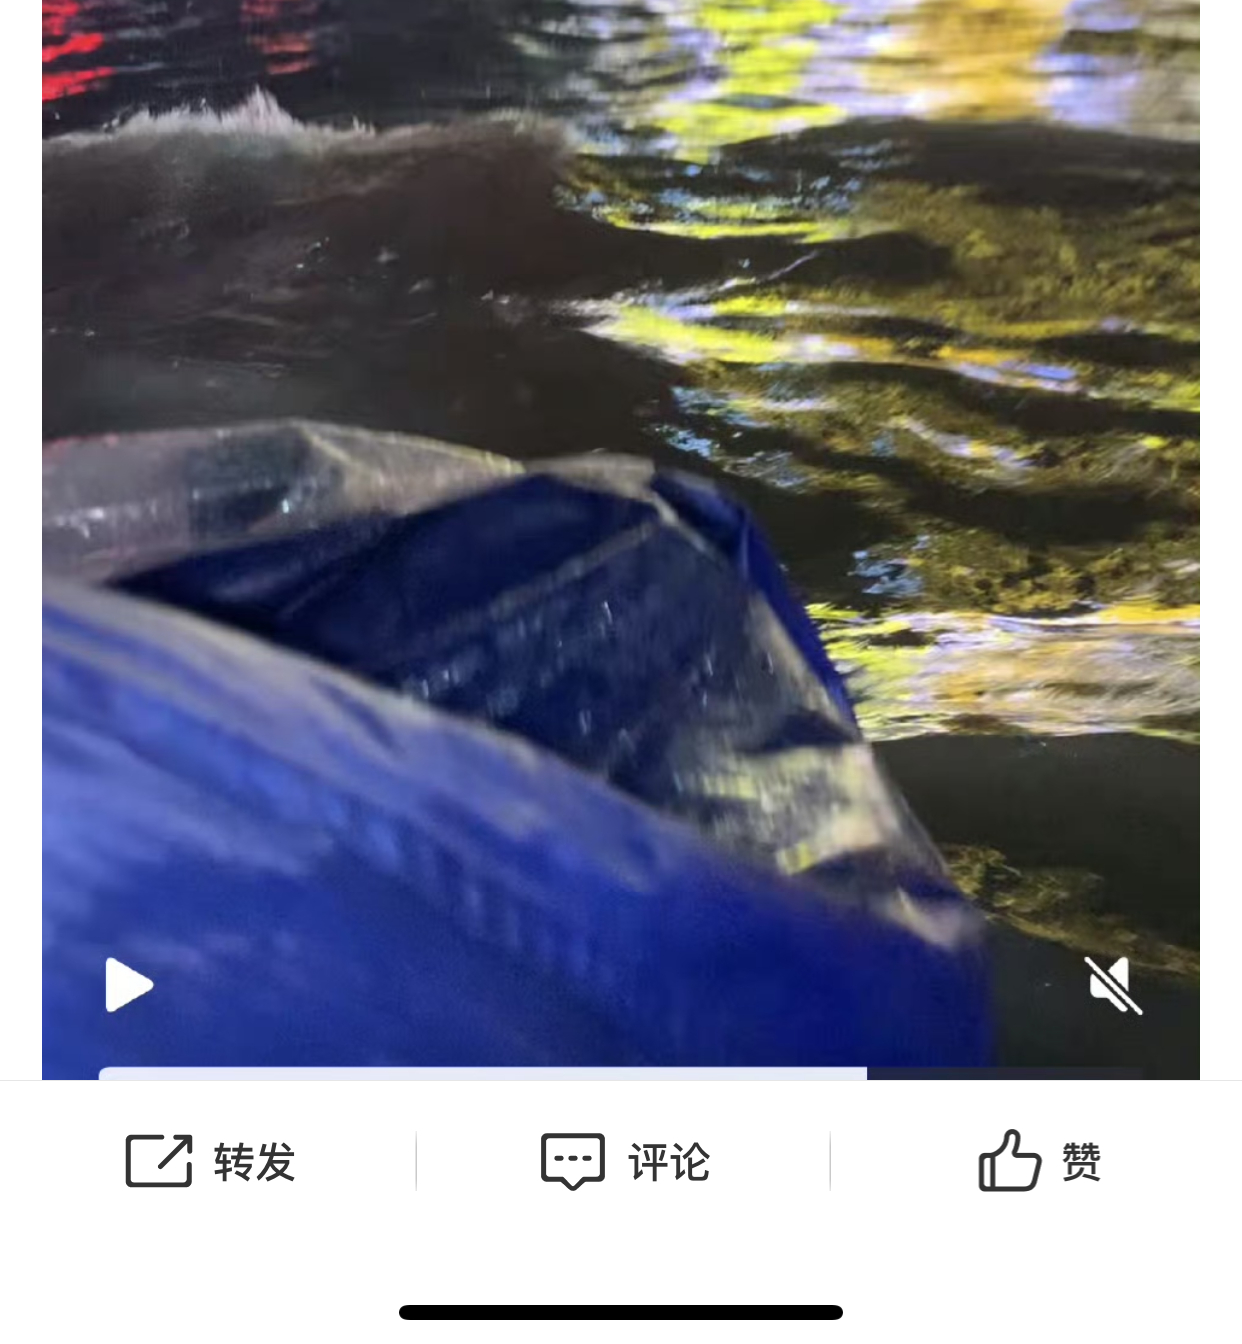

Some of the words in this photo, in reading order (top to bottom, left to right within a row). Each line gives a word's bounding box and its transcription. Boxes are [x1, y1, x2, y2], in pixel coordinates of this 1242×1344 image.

[213, 1141, 295, 1183] 转发
[627, 1141, 711, 1183] 评论
[1062, 1141, 1101, 1183] 赞
